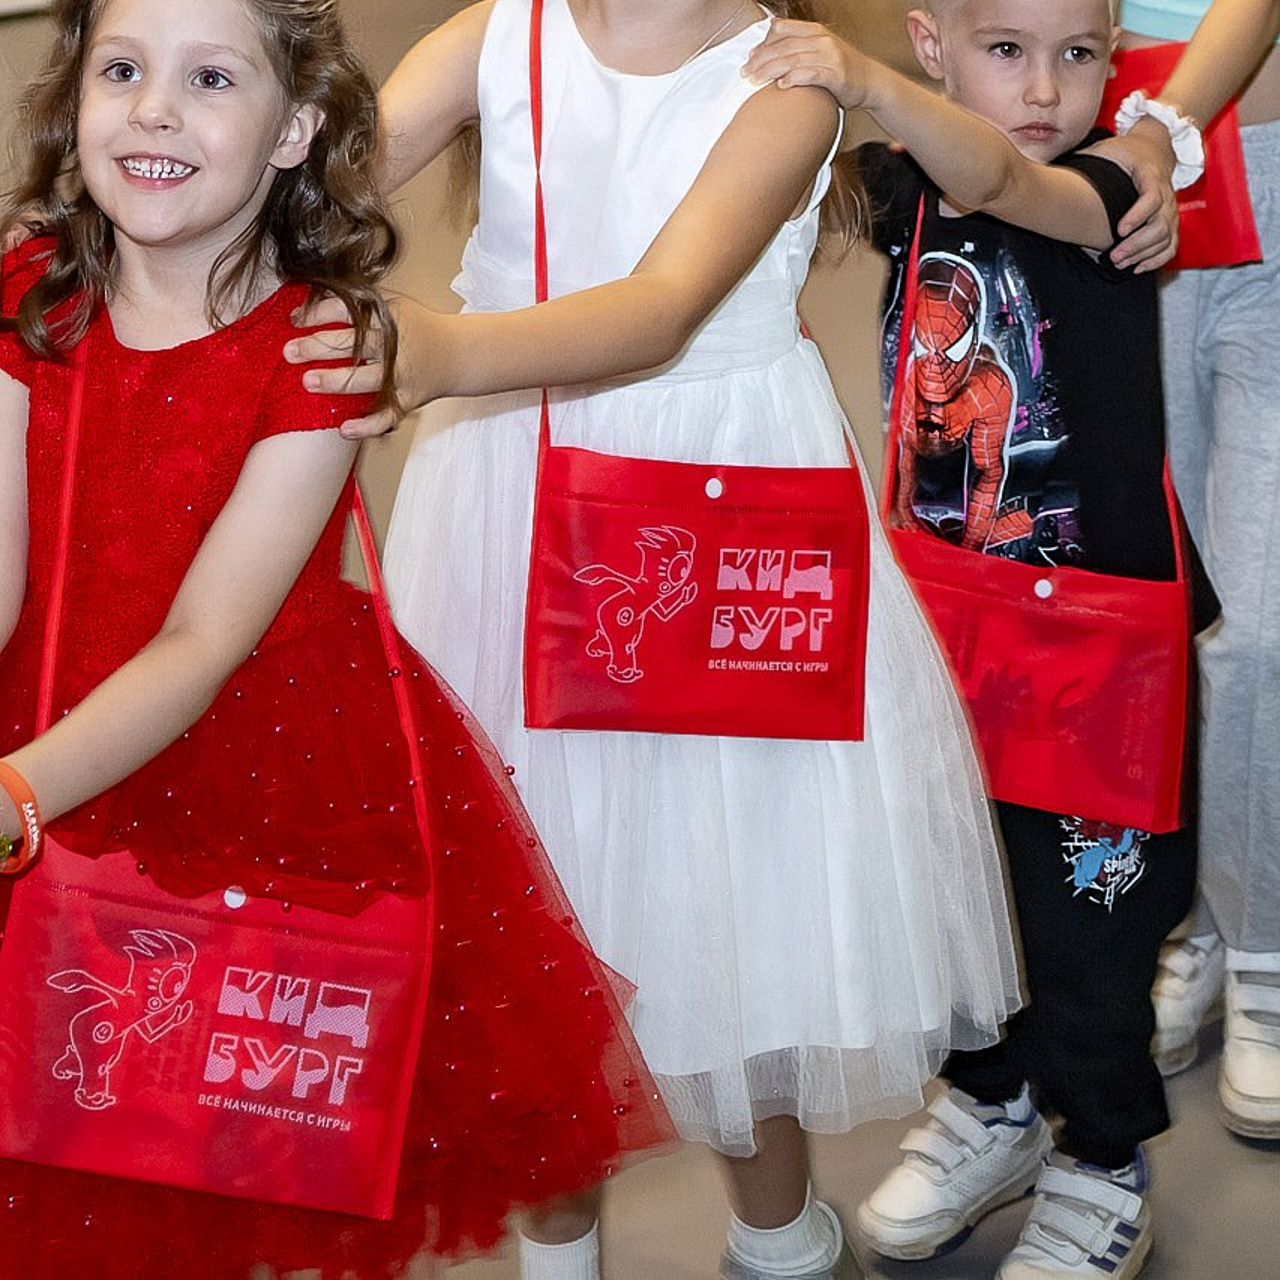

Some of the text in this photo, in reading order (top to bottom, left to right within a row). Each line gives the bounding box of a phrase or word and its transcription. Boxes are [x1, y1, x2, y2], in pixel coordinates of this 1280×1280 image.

[717, 548, 833, 600] КИД
[711, 606, 832, 651] БУРГ
[728, 659, 793, 672] НАЧИНАЕТСЯ
[794, 661, 802, 672] С
[803, 661, 829, 673] ИГРЫ
[217, 966, 371, 1049] КИД
[203, 1032, 364, 1106] БУРГ
[222, 1097, 304, 1124] НАЧИНАЕТСЯ
[306, 1113, 316, 1124] С
[317, 1114, 351, 1132] ИГРЫ
